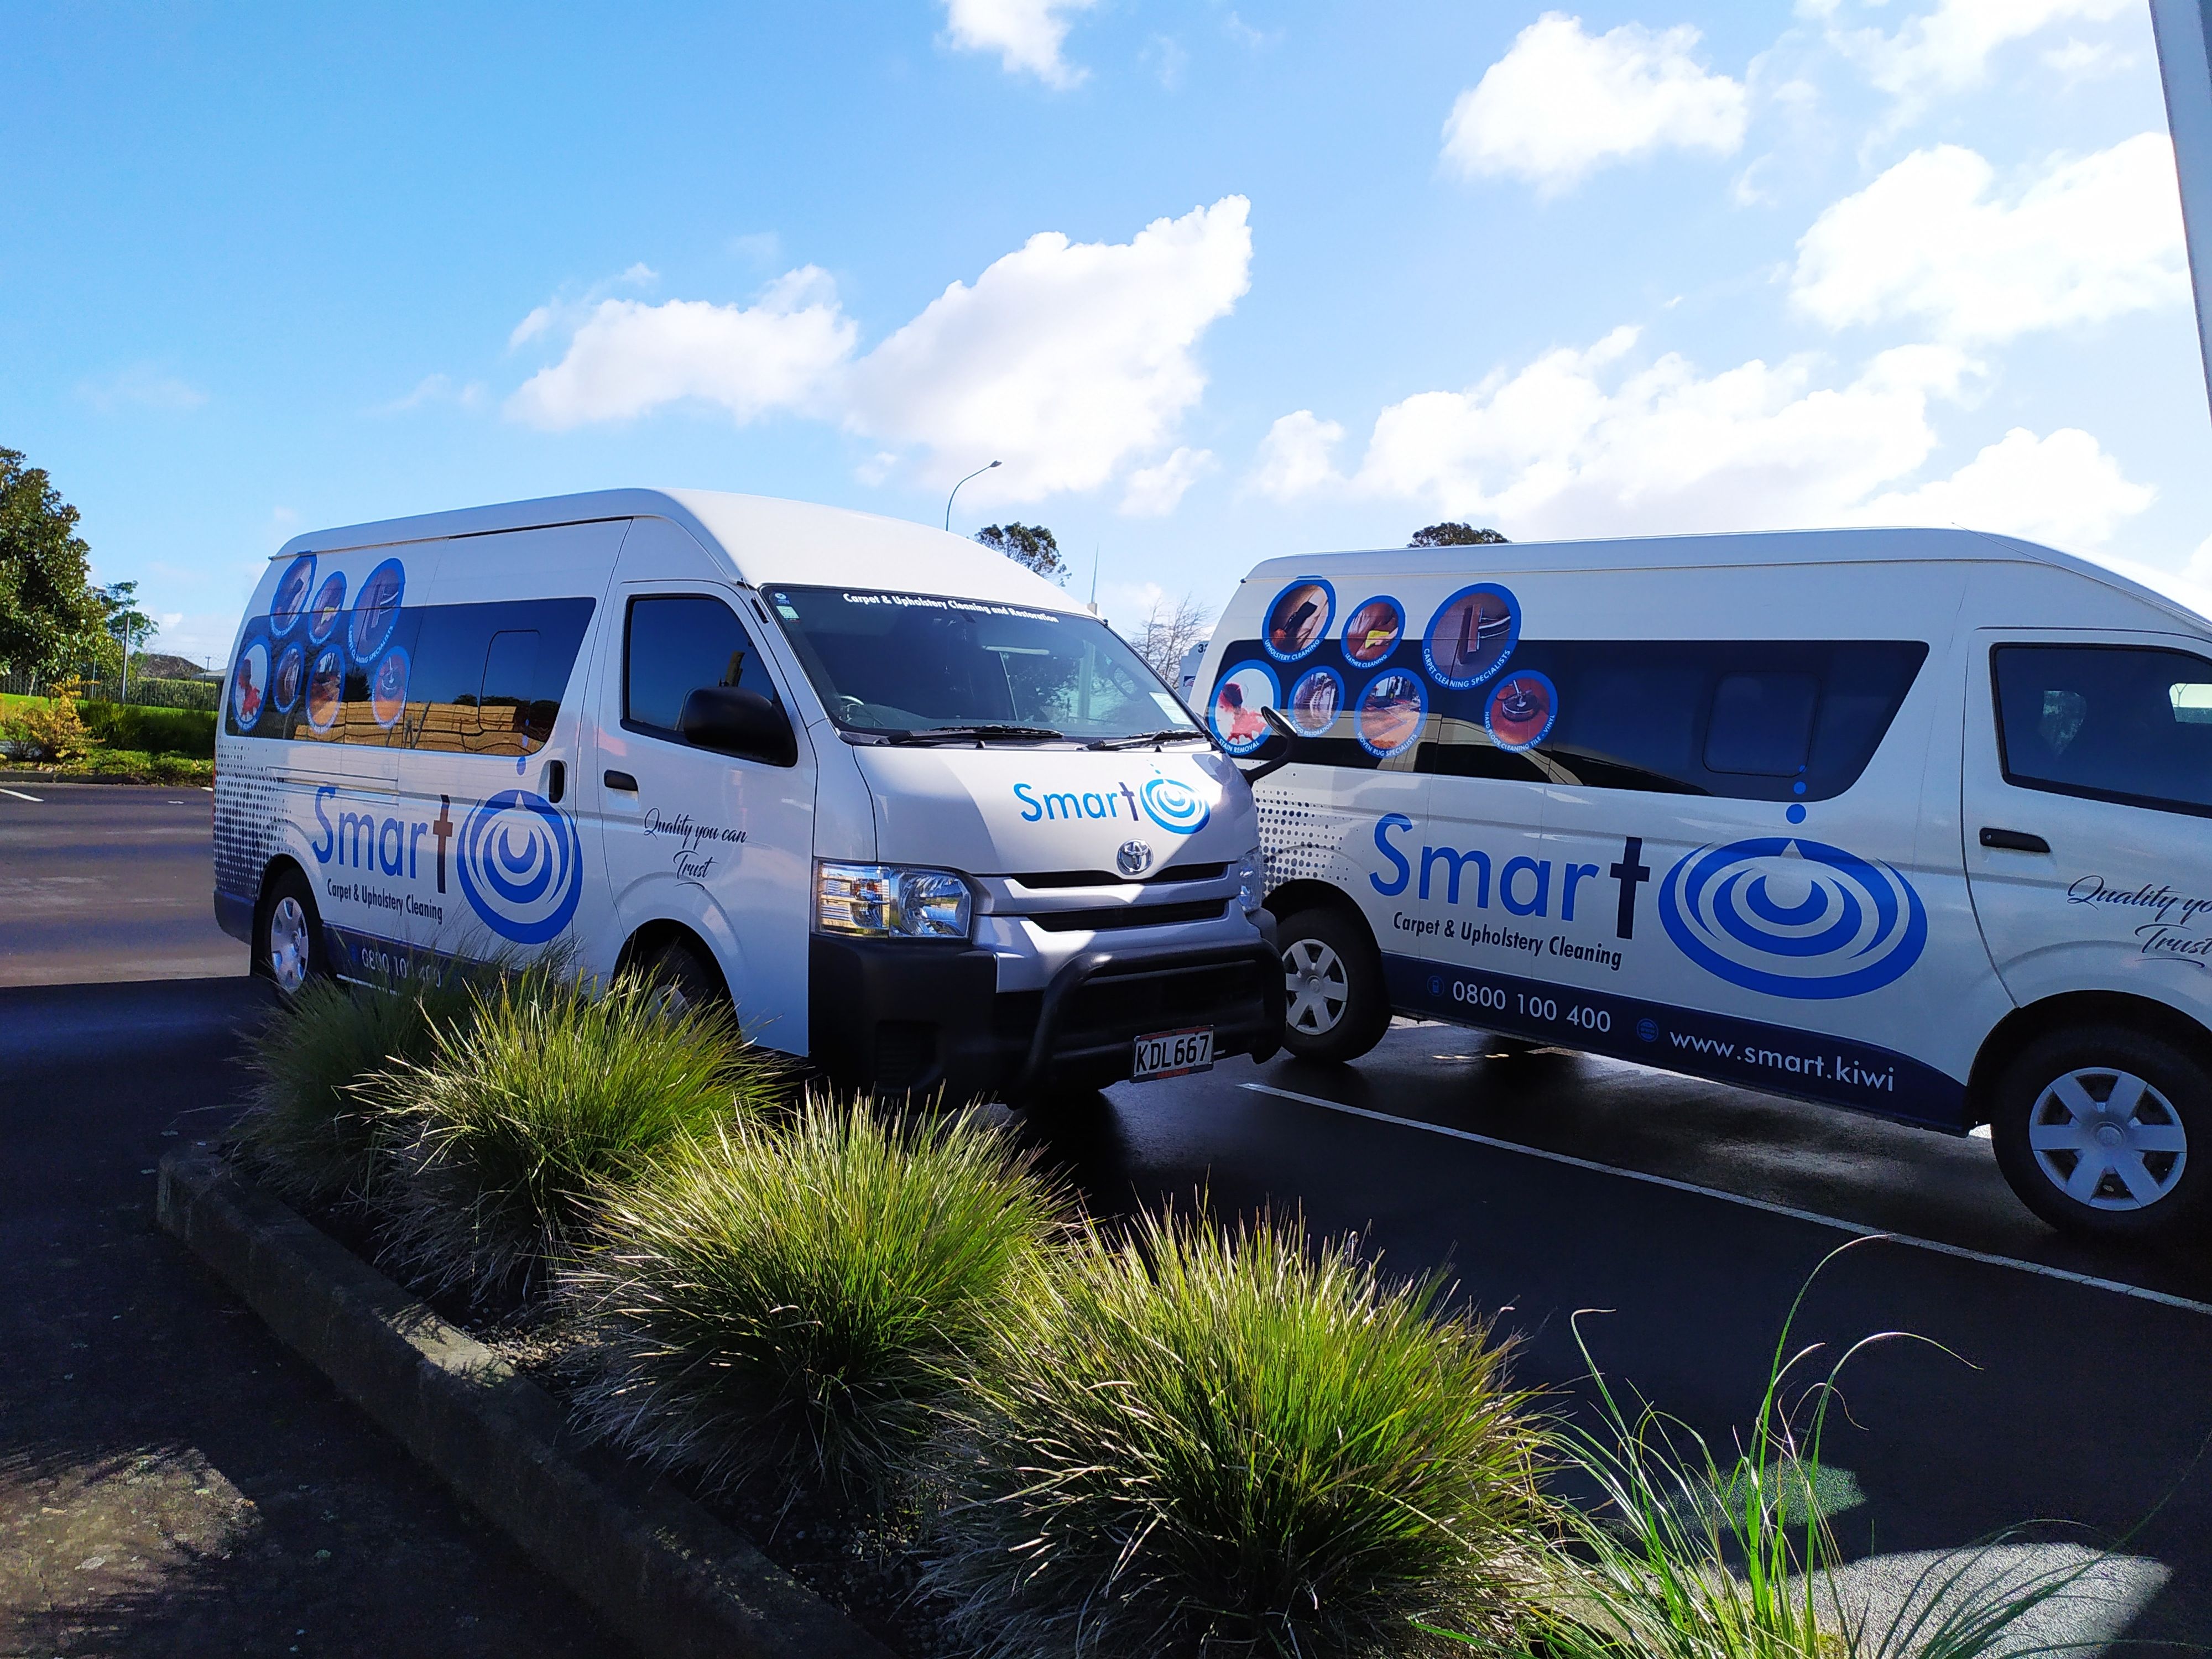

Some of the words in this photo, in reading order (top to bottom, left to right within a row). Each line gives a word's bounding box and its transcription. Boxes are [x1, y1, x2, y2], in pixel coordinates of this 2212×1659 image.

[843, 593, 880, 605] Carpet
[883, 595, 891, 604] &
[893, 596, 947, 609] Upholstery
[948, 601, 992, 614] Cleaning
[991, 607, 1009, 615] and
[1008, 608, 1059, 623] Restoration
[1264, 639, 1291, 660] UPHOLSTERY
[1291, 639, 1320, 660] CLEANING
[1345, 653, 1361, 667] LEATHER
[1362, 654, 1388, 667] CLEANING
[1424, 648, 1437, 674] CARPET
[1434, 673, 1469, 687] CLEANING
[1471, 650, 1511, 685] SPECIALISTS
[1218, 738, 1233, 752] STAIN
[1233, 740, 1260, 753] REMOVAL
[1292, 720, 1304, 733] FLOOD
[1304, 721, 1333, 735] RESTORATION
[1357, 731, 1373, 752] WOVEN
[1386, 734, 1417, 757] SPECIALISTS
[1488, 729, 1501, 746] FLOOR
[1501, 743, 1530, 752] CLEANING
[1530, 736, 1541, 746] TILE
[1543, 715, 1555, 732] VINYL
[1013, 782, 1139, 822] Smart
[312, 786, 453, 894] Smart
[643, 807, 695, 849] Quality
[693, 825, 719, 851] you
[721, 828, 747, 843] can
[673, 850, 719, 879] Trust
[1369, 813, 1650, 940] Smart
[327, 878, 352, 902] Carpet
[353, 884, 359, 902] &
[362, 885, 404, 916] Upholstery
[406, 894, 442, 925] Cleaning
[2067, 875, 2183, 922] Quality
[1394, 911, 1439, 936] Carpet
[1444, 919, 1455, 937] &
[1461, 921, 1543, 956] Upholstery
[1549, 936, 1623, 971] Cleaning
[393, 956, 414, 978] 10
[1453, 980, 1506, 1010] 0800
[1517, 994, 1557, 1021] 100
[1566, 1005, 1611, 1033] 400
[1136, 1035, 1209, 1072] KDL667
[1670, 1031, 1894, 1092] www.smart.kiwi
